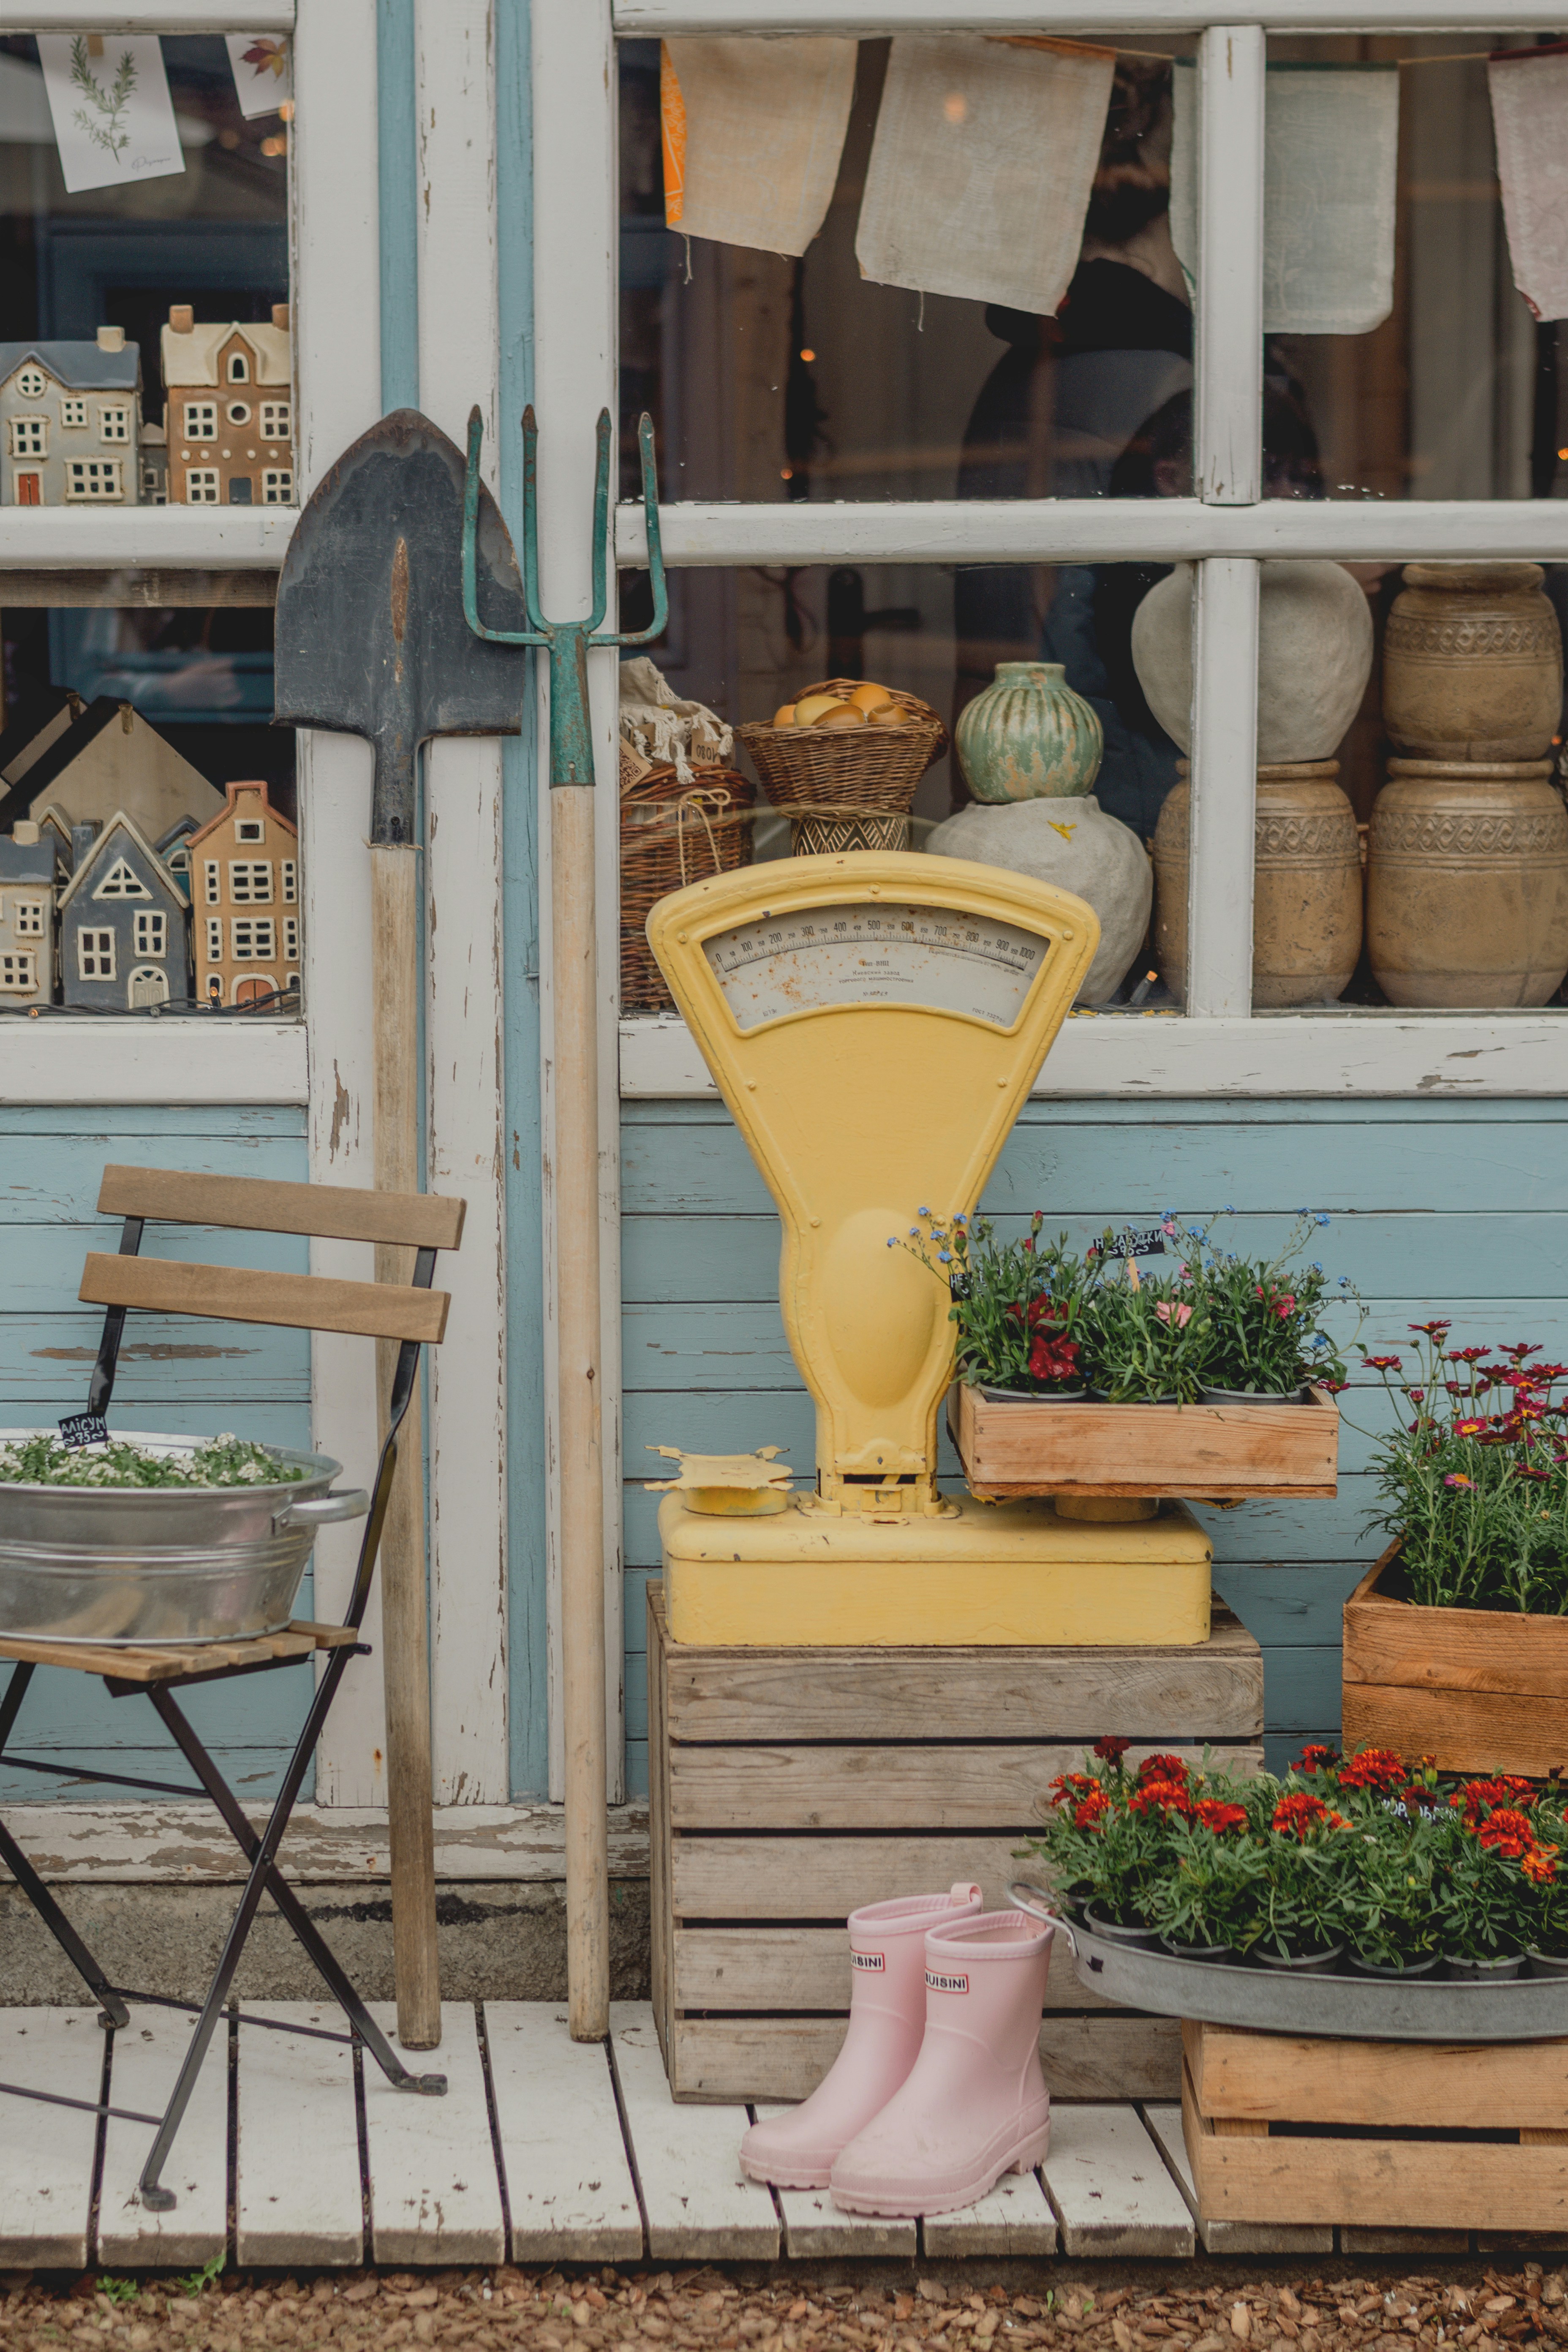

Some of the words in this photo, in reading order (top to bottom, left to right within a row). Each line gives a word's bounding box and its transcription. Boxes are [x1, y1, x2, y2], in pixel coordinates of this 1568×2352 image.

[716, 953, 722, 962] 0
[740, 941, 753, 952] 100
[769, 932, 782, 944] 200
[800, 926, 814, 936] 300
[834, 922, 847, 932] 400
[868, 920, 880, 930] 500
[901, 921, 914, 931] 600
[934, 925, 947, 936] 700
[966, 931, 980, 943] 800
[996, 939, 1010, 951] 900
[1018, 947, 1036, 960] 1000
[75, 1430, 90, 1444] 75
